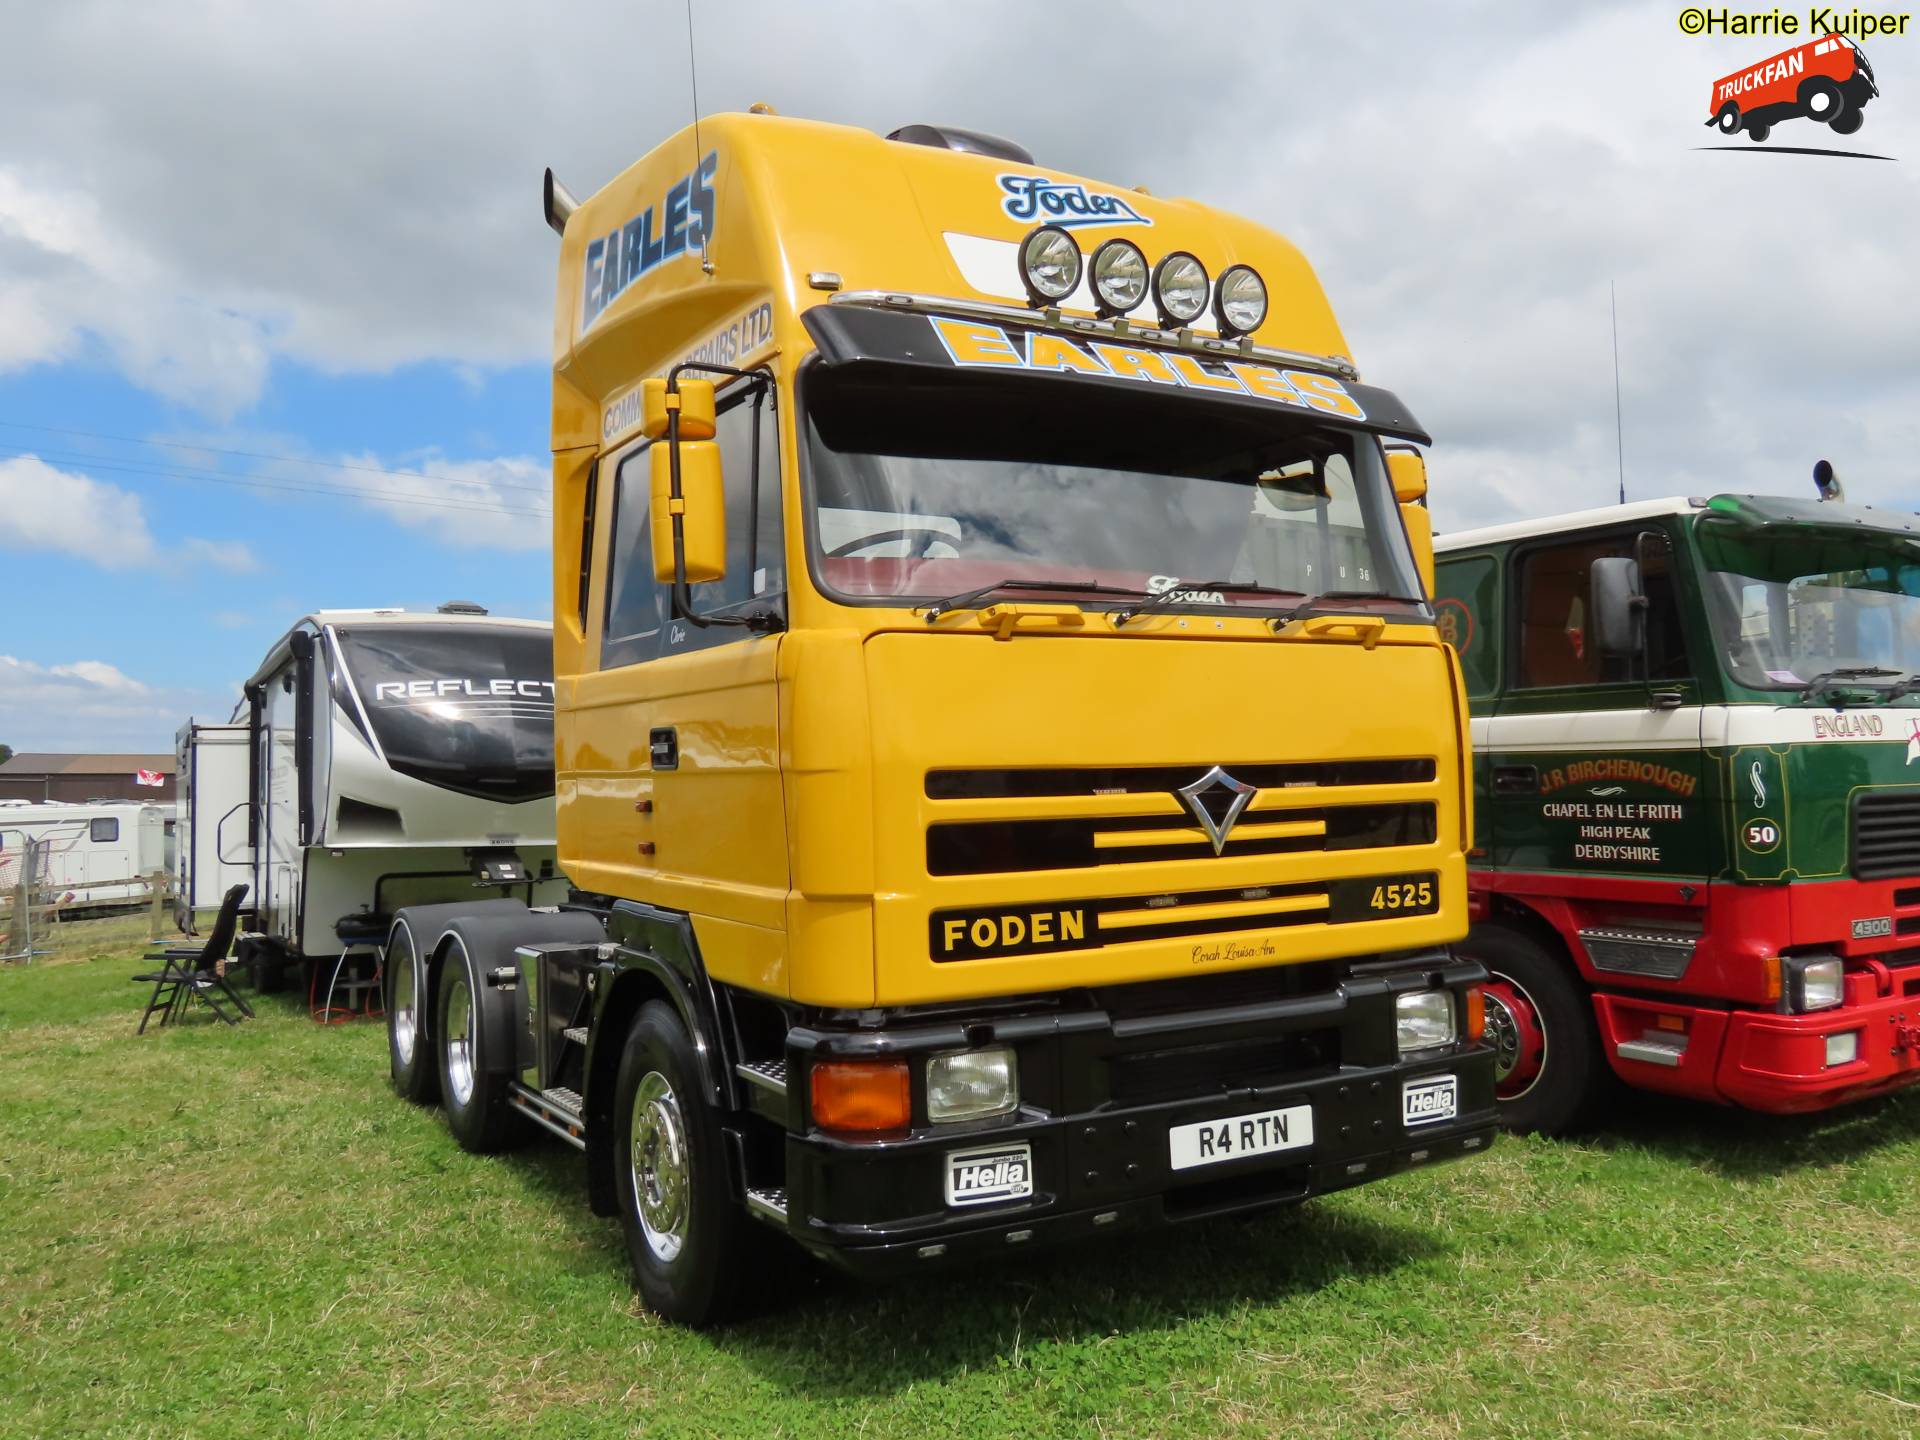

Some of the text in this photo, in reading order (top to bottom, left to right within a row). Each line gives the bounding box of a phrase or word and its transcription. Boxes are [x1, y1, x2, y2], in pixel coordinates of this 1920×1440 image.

[998, 175, 1152, 229] Foden
[583, 150, 717, 336] EARLES
[741, 303, 773, 356] LTD.
[928, 316, 1366, 421] EARLES
[1814, 714, 1883, 738] ENGLAND
[1565, 759, 1697, 798] BIRCHENOUGH
[1581, 826, 1651, 840] HIGH PEAK
[1749, 826, 1775, 843] 50
[1575, 844, 1660, 861] DERBYSHIRE
[1371, 882, 1432, 910] 4525
[943, 909, 1085, 951] FODEN
[1854, 919, 1889, 936] 4300
[1409, 1090, 1452, 1113] Hella
[1199, 1114, 1289, 1157] R4 RTN
[958, 1163, 1024, 1190] Hella
